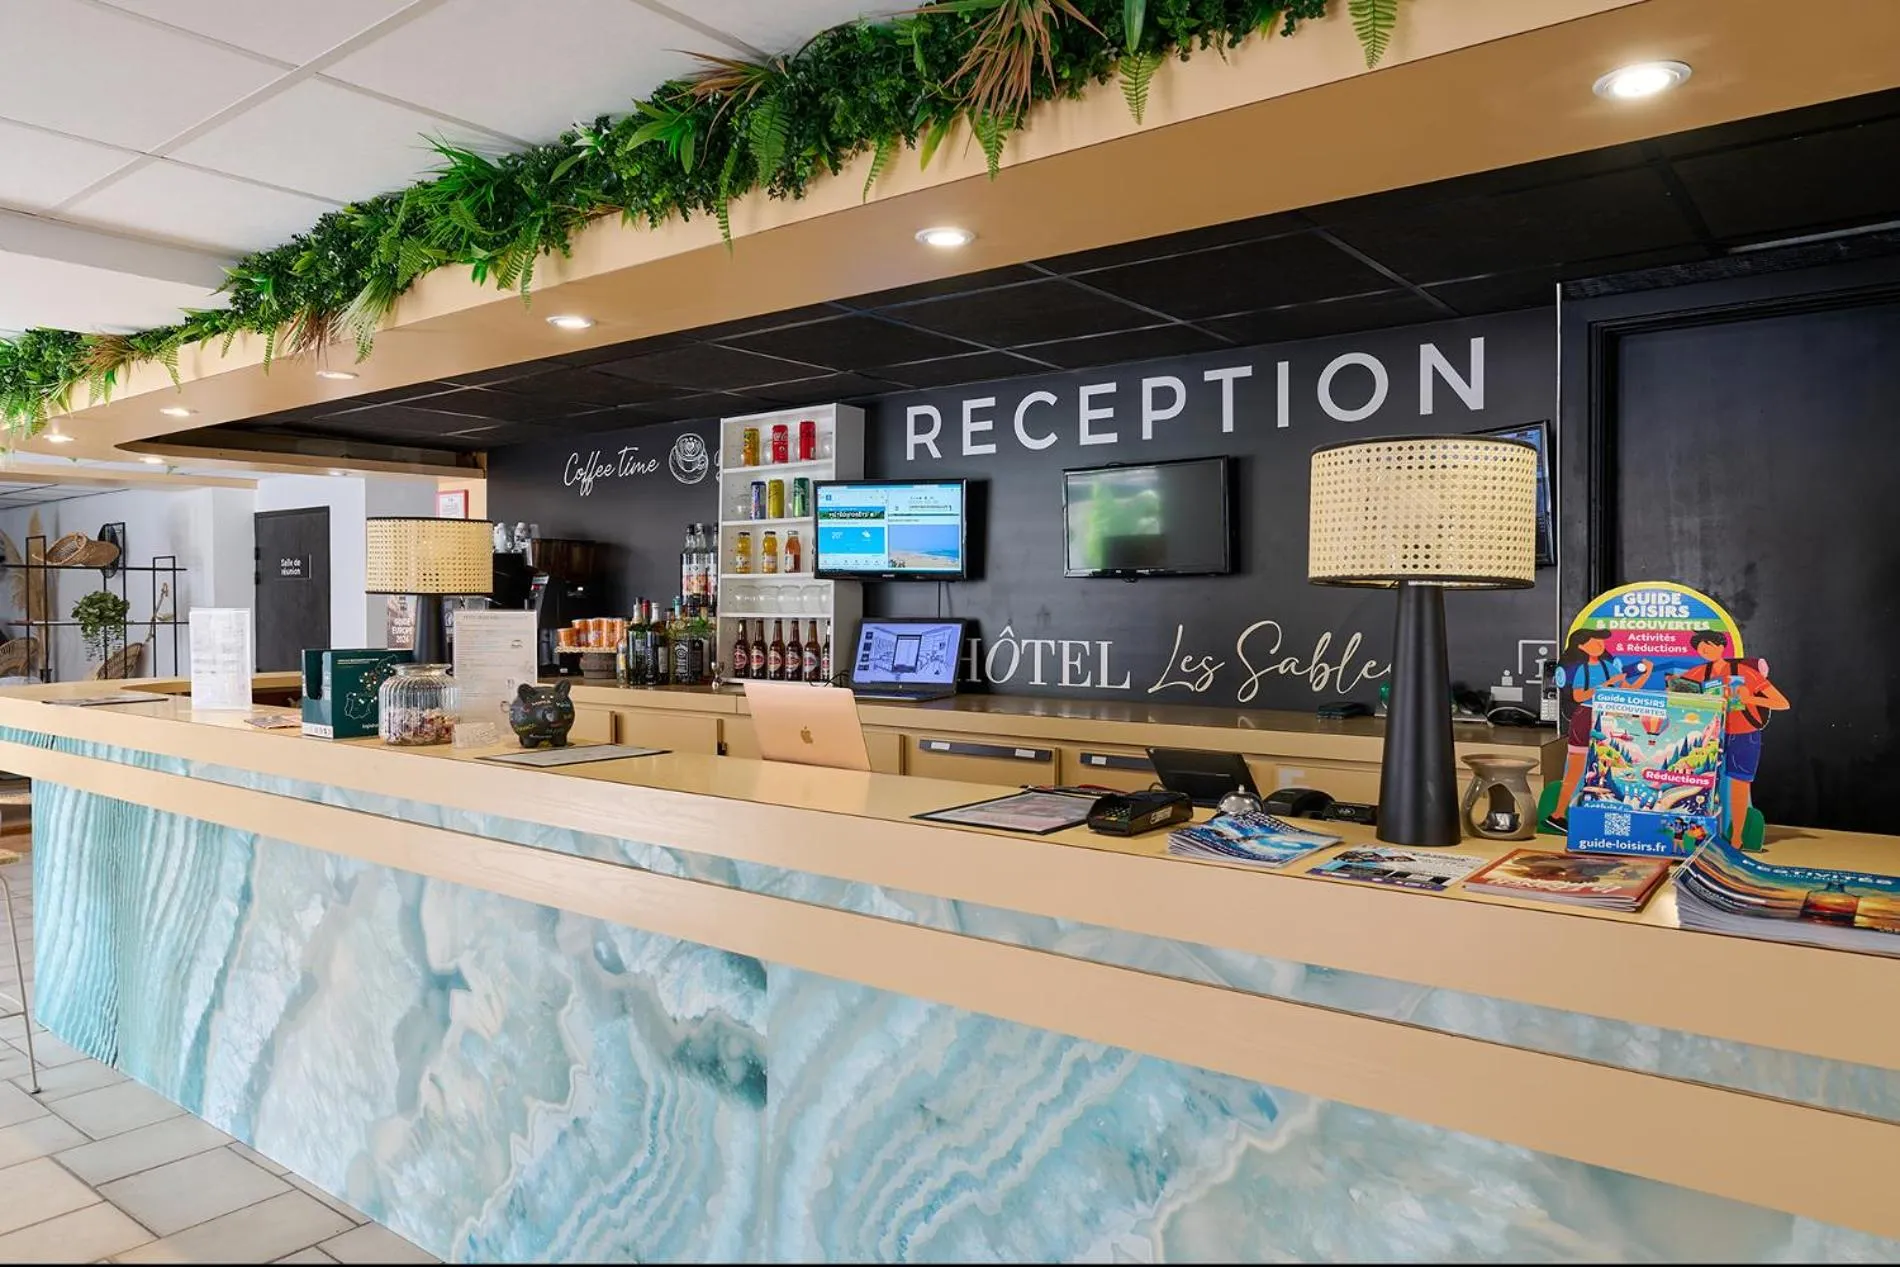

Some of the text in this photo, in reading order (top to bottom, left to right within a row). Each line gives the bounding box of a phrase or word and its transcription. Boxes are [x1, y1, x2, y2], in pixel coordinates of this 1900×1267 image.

[906, 336, 1485, 461] RECEPTION
[563, 446, 660, 497] Coffee time
[280, 558, 301, 567] Salle de
[280, 568, 301, 576] réunion
[1622, 592, 1682, 605] GUIDE
[1613, 605, 1691, 618] LOISIRS
[1595, 617, 1710, 631] & DÉCOUVERTES
[1628, 632, 1677, 642] Activités
[1616, 642, 1688, 654] & Réductions
[1147, 623, 1226, 694] Les
[1236, 620, 1392, 703] Sable
[1597, 693, 1666, 708] Guide LOISIRS
[1645, 770, 1711, 786] Réductions
[1578, 838, 1667, 853] guide-loisirs.fr
